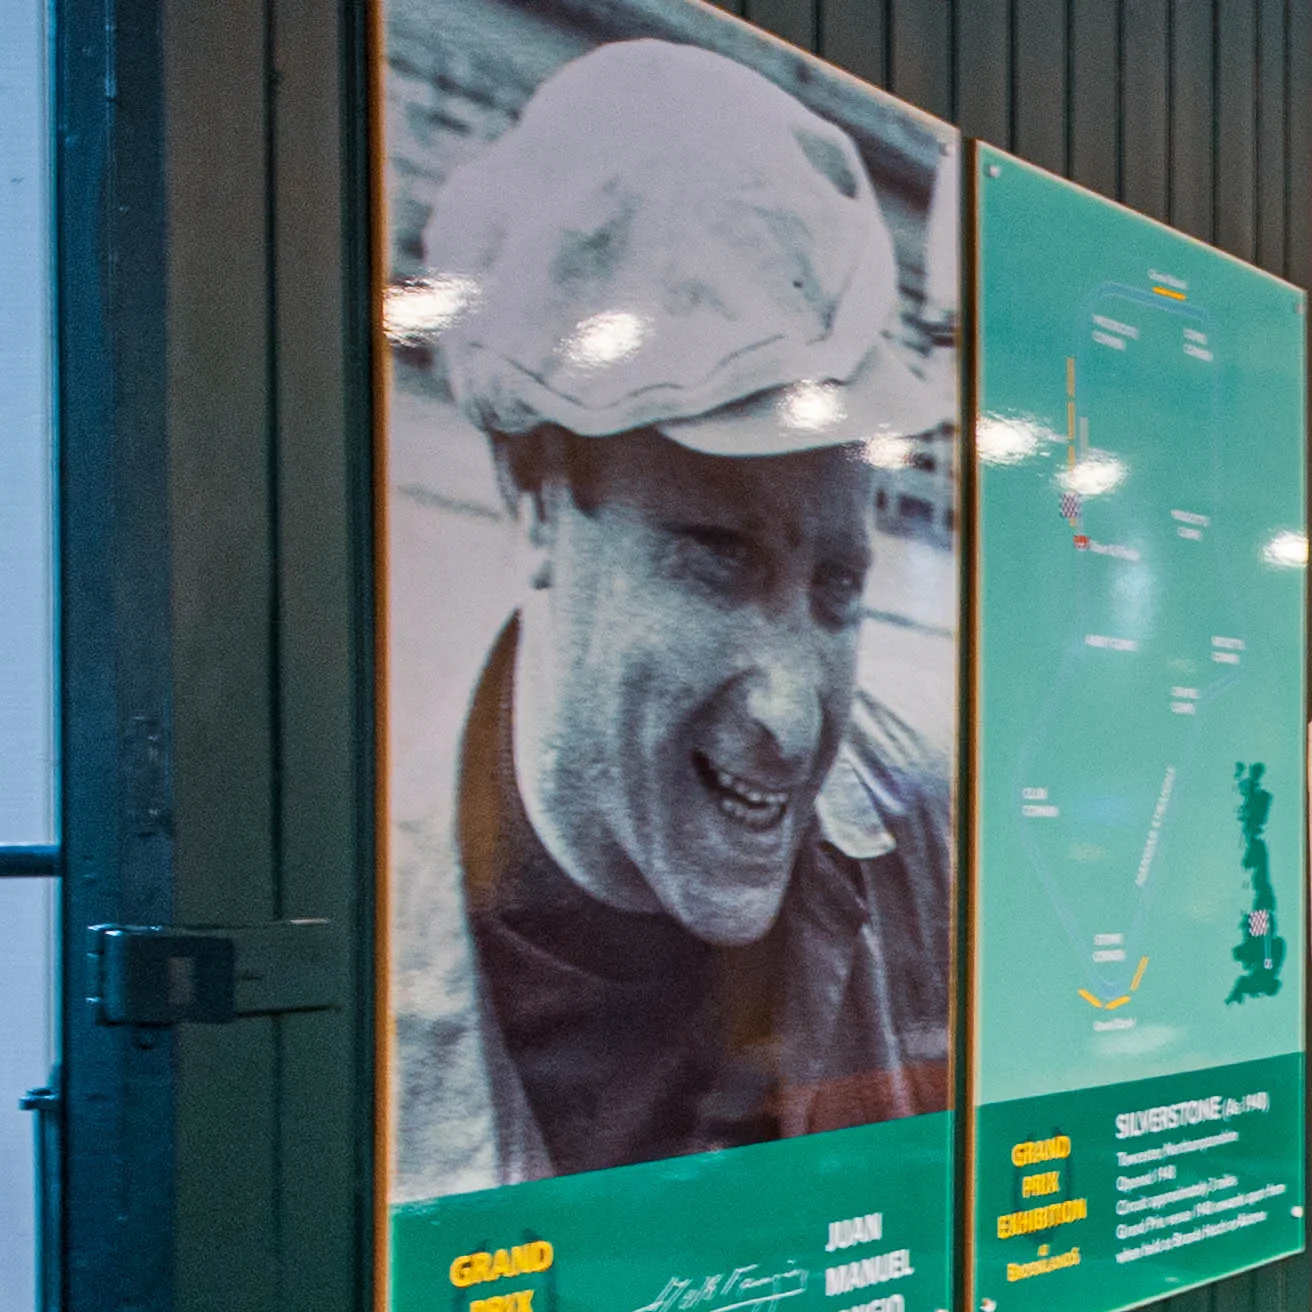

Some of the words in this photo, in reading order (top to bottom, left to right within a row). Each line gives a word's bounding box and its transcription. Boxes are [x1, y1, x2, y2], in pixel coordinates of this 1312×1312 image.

[1115, 1096, 1222, 1139] SILVERSTONE
[1012, 1135, 1071, 1167] GRAND
[1022, 1171, 1060, 1198] PRIX
[825, 1212, 883, 1252] JUAN
[997, 1198, 1087, 1239] EXHIBITION
[450, 1240, 554, 1288] GRAND
[825, 1249, 915, 1296] MANUEL
